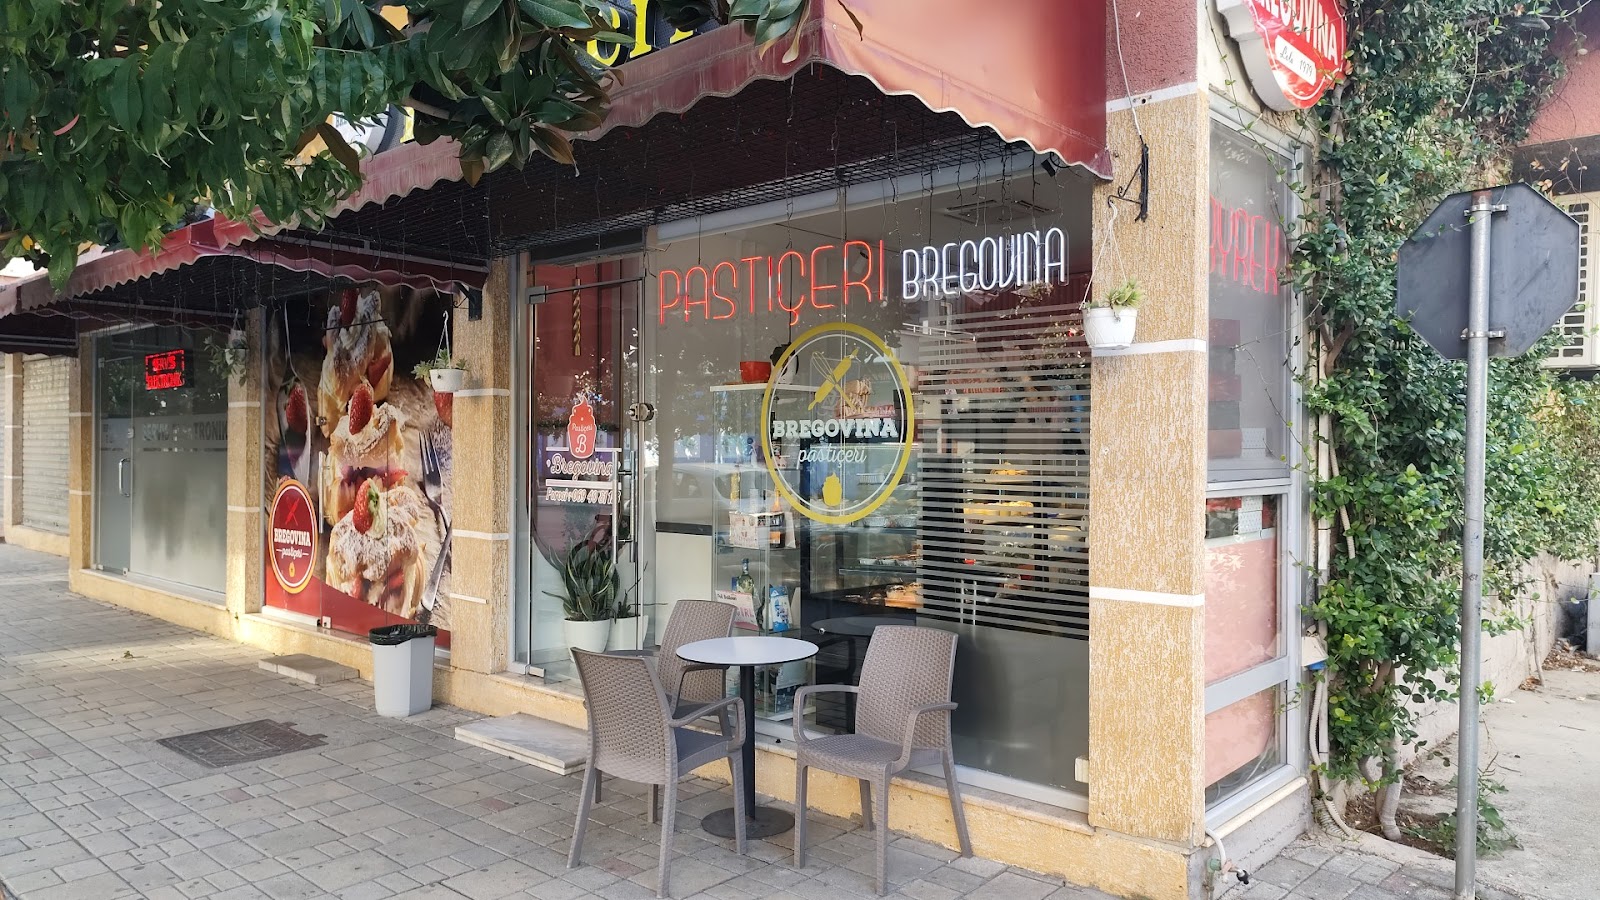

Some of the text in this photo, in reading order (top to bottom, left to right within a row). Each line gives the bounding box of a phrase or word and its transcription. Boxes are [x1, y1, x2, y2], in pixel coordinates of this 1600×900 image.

[1257, 0, 1339, 66] GOVINA
[659, 227, 1065, 326] PASTIÇERI BREGOVINA
[773, 417, 899, 439] BREGOVINA
[575, 433, 587, 454] B
[798, 442, 868, 468] pastiçeri
[273, 528, 311, 546] BREGOVINA
